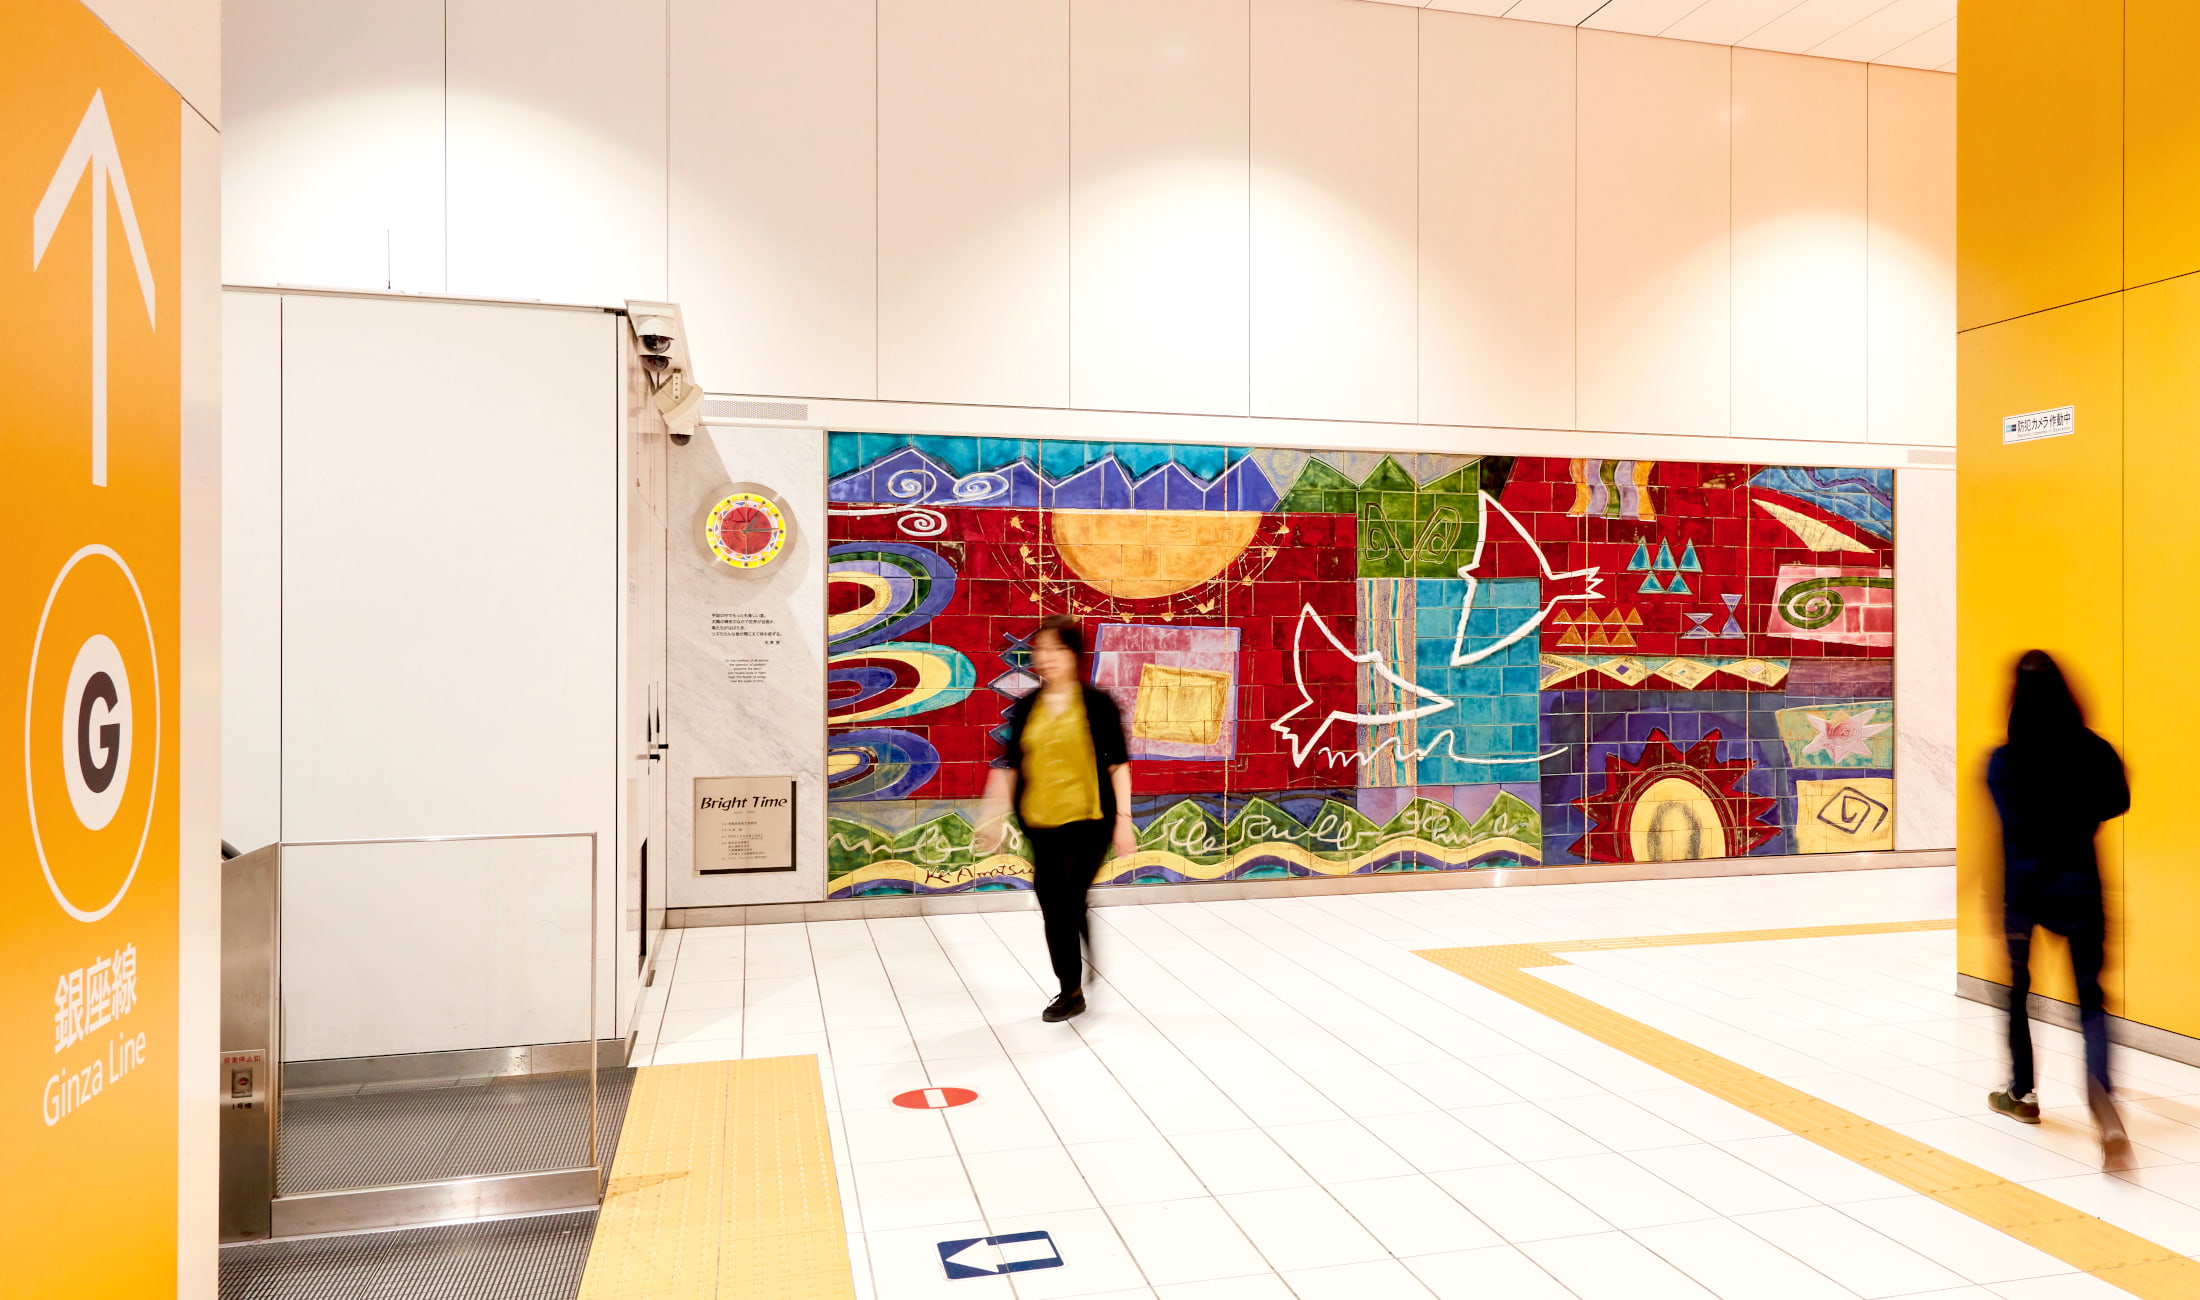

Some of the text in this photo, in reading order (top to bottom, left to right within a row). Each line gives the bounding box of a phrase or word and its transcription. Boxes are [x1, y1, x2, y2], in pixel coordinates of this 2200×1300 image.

[2017, 411, 2071, 433] 防犯カメラ作動中
[78, 671, 121, 794] G
[700, 796, 788, 812] Bright Time
[54, 942, 137, 1055] 銀座線
[43, 1031, 146, 1127] Ginza Line
